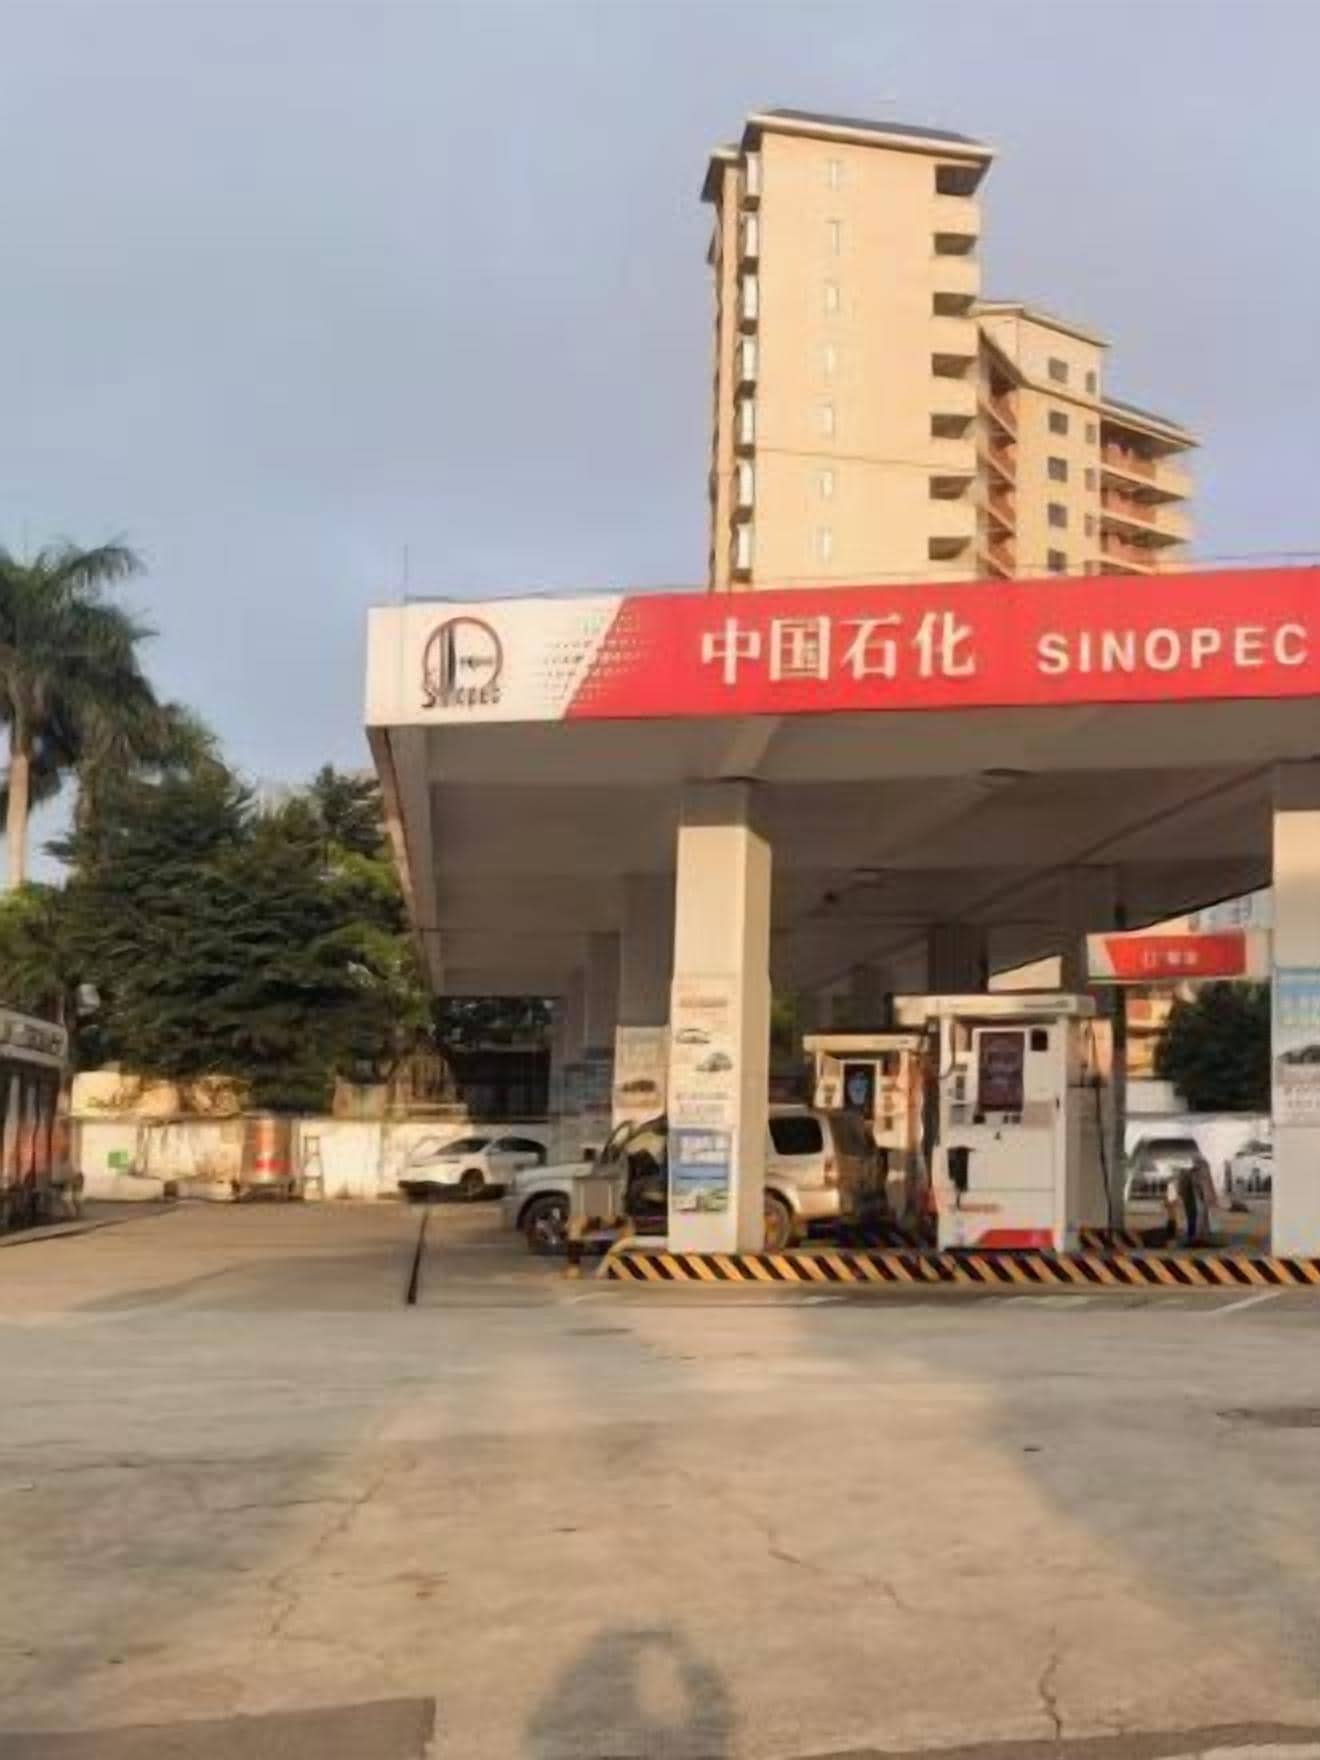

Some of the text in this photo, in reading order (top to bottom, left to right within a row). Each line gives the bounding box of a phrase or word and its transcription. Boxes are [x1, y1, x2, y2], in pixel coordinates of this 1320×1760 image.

[701, 611, 977, 686] 中国石化
[1037, 623, 1309, 676] SINOPEC
